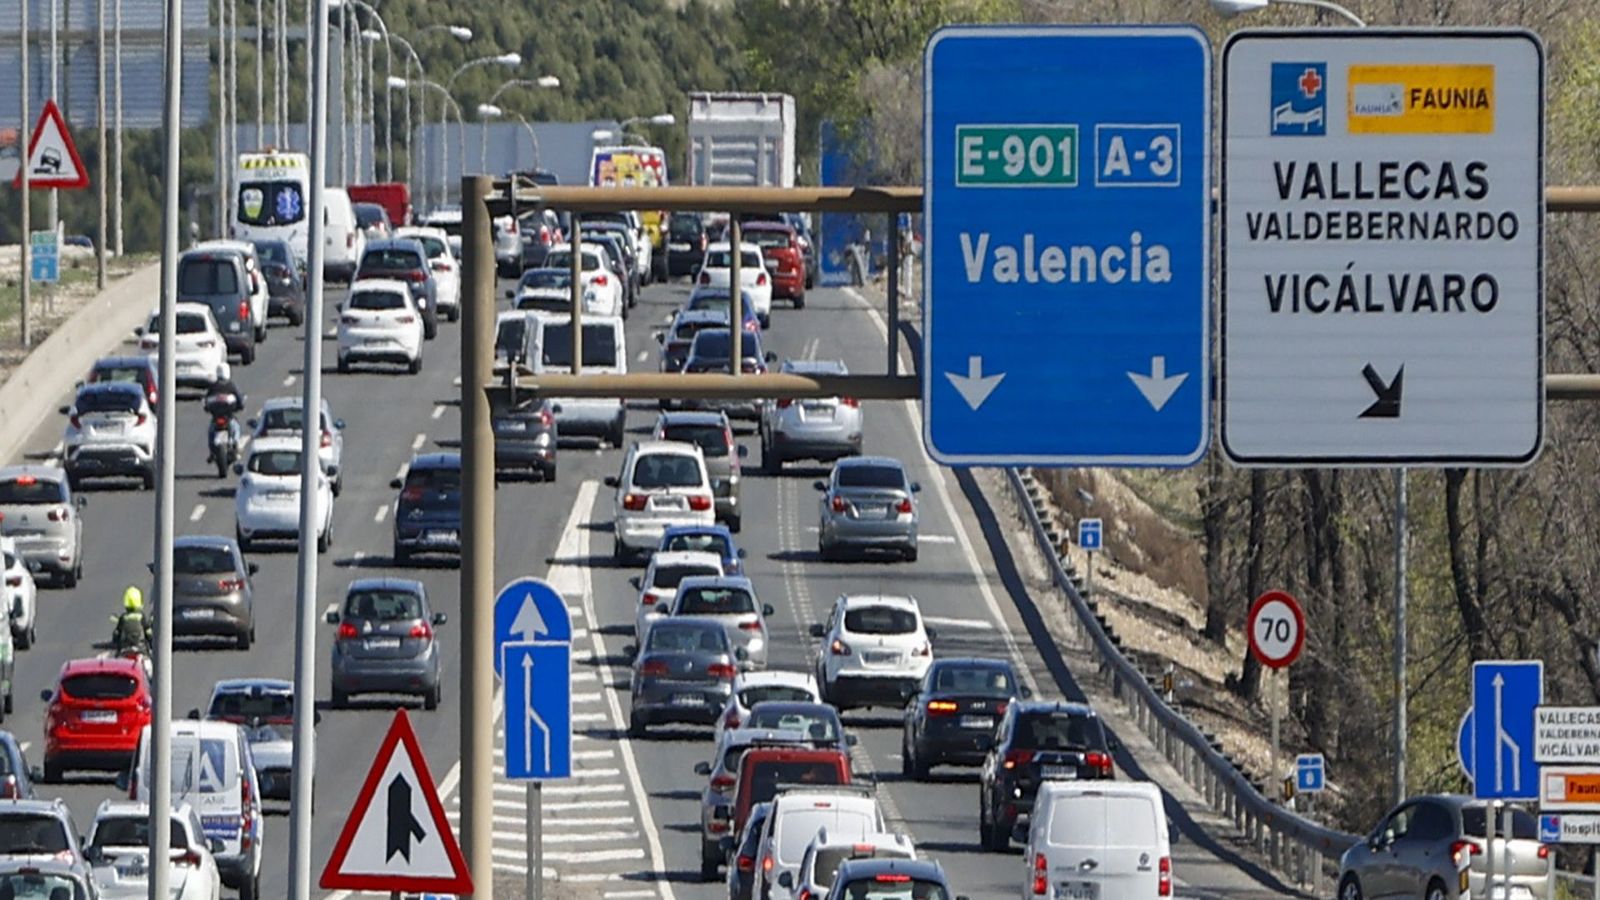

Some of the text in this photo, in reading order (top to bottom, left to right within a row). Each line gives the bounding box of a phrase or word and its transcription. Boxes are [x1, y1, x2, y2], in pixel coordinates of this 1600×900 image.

[1410, 87, 1489, 109] FAUNIA
[962, 135, 1072, 176] E-901
[1103, 135, 1173, 176] A-3
[1273, 161, 1490, 200] VALLECAS
[1246, 210, 1520, 241] VALDEBERNARDO
[959, 231, 1173, 284] Valencia
[1264, 261, 1500, 314] VICÁLVARO
[1261, 617, 1290, 642] 70
[1540, 711, 1600, 725] VALLECAS
